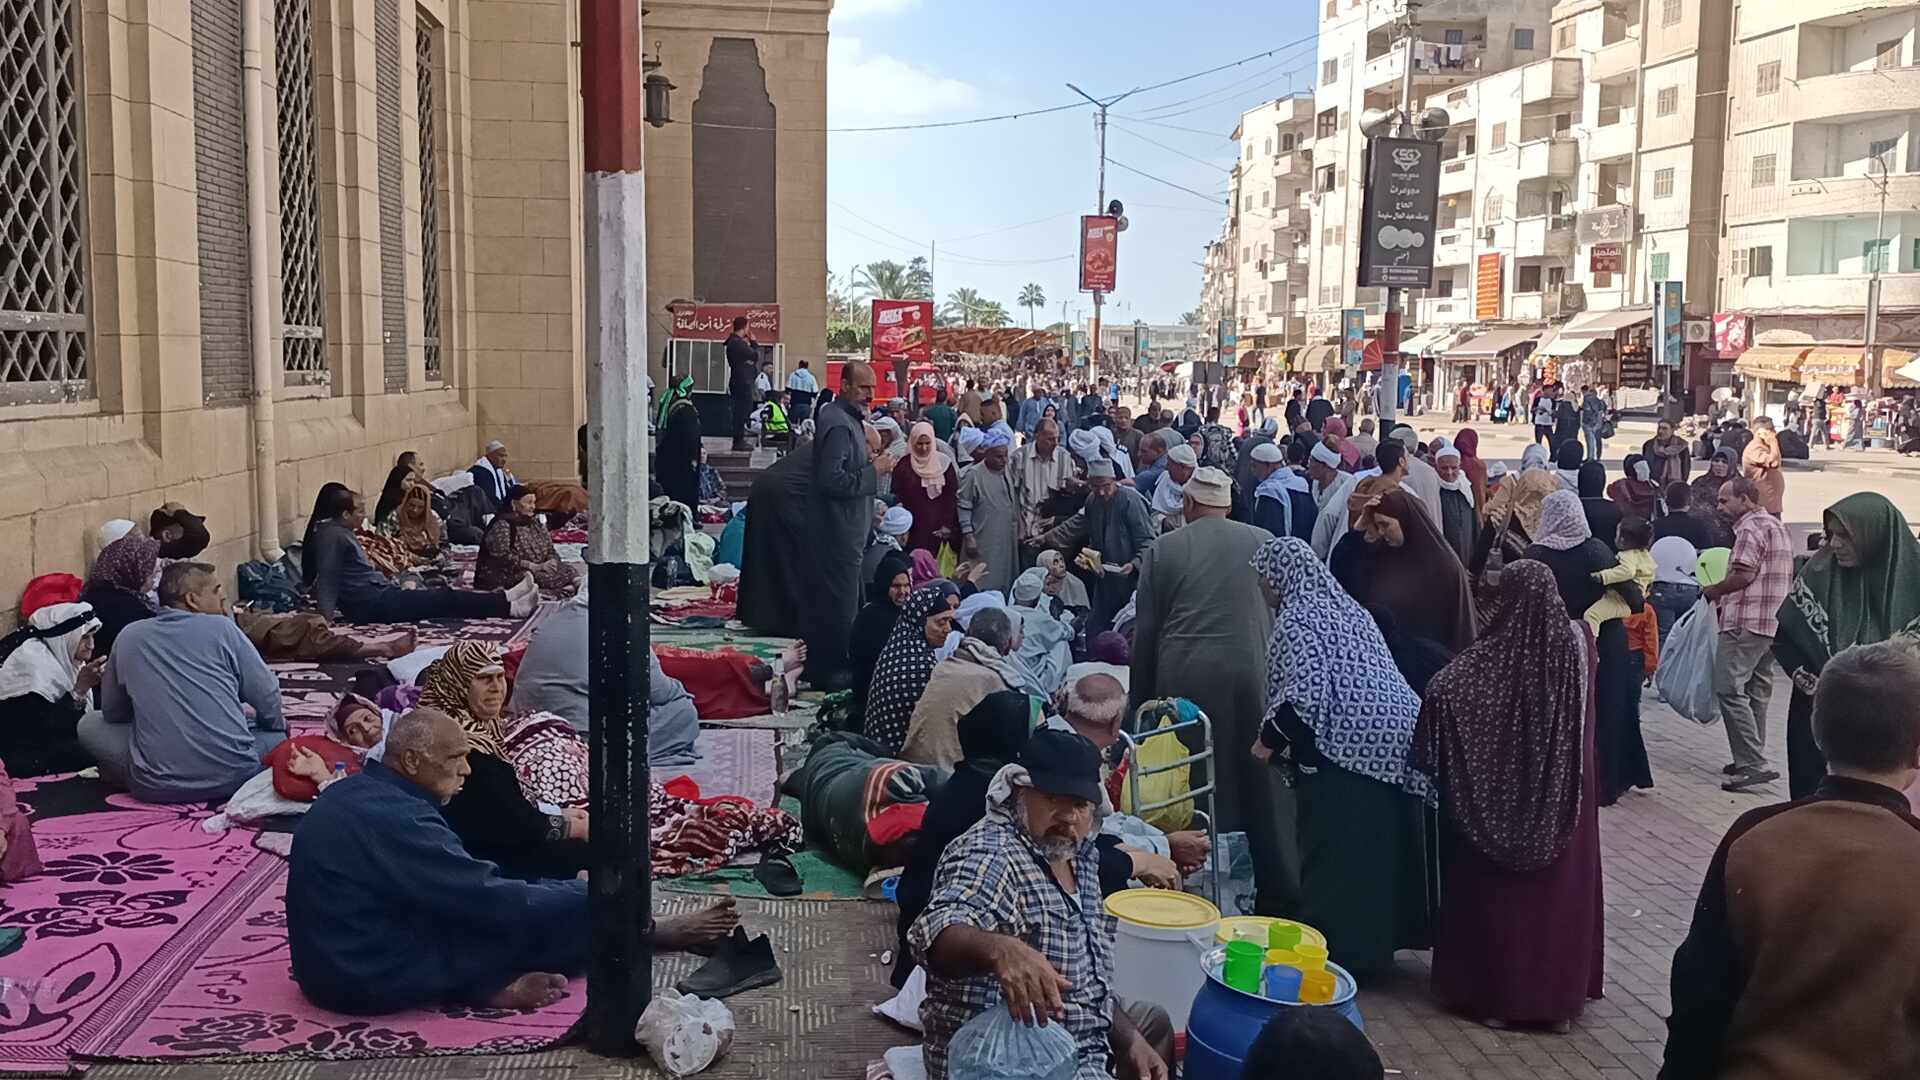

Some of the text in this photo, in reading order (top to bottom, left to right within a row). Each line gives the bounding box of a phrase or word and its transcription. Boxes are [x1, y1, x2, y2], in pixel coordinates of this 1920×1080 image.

[1389, 185, 1420, 196] مجوهرات
[1395, 201, 1414, 210] الحاج
[676, 315, 731, 332] شرطة أمن الصاغة
